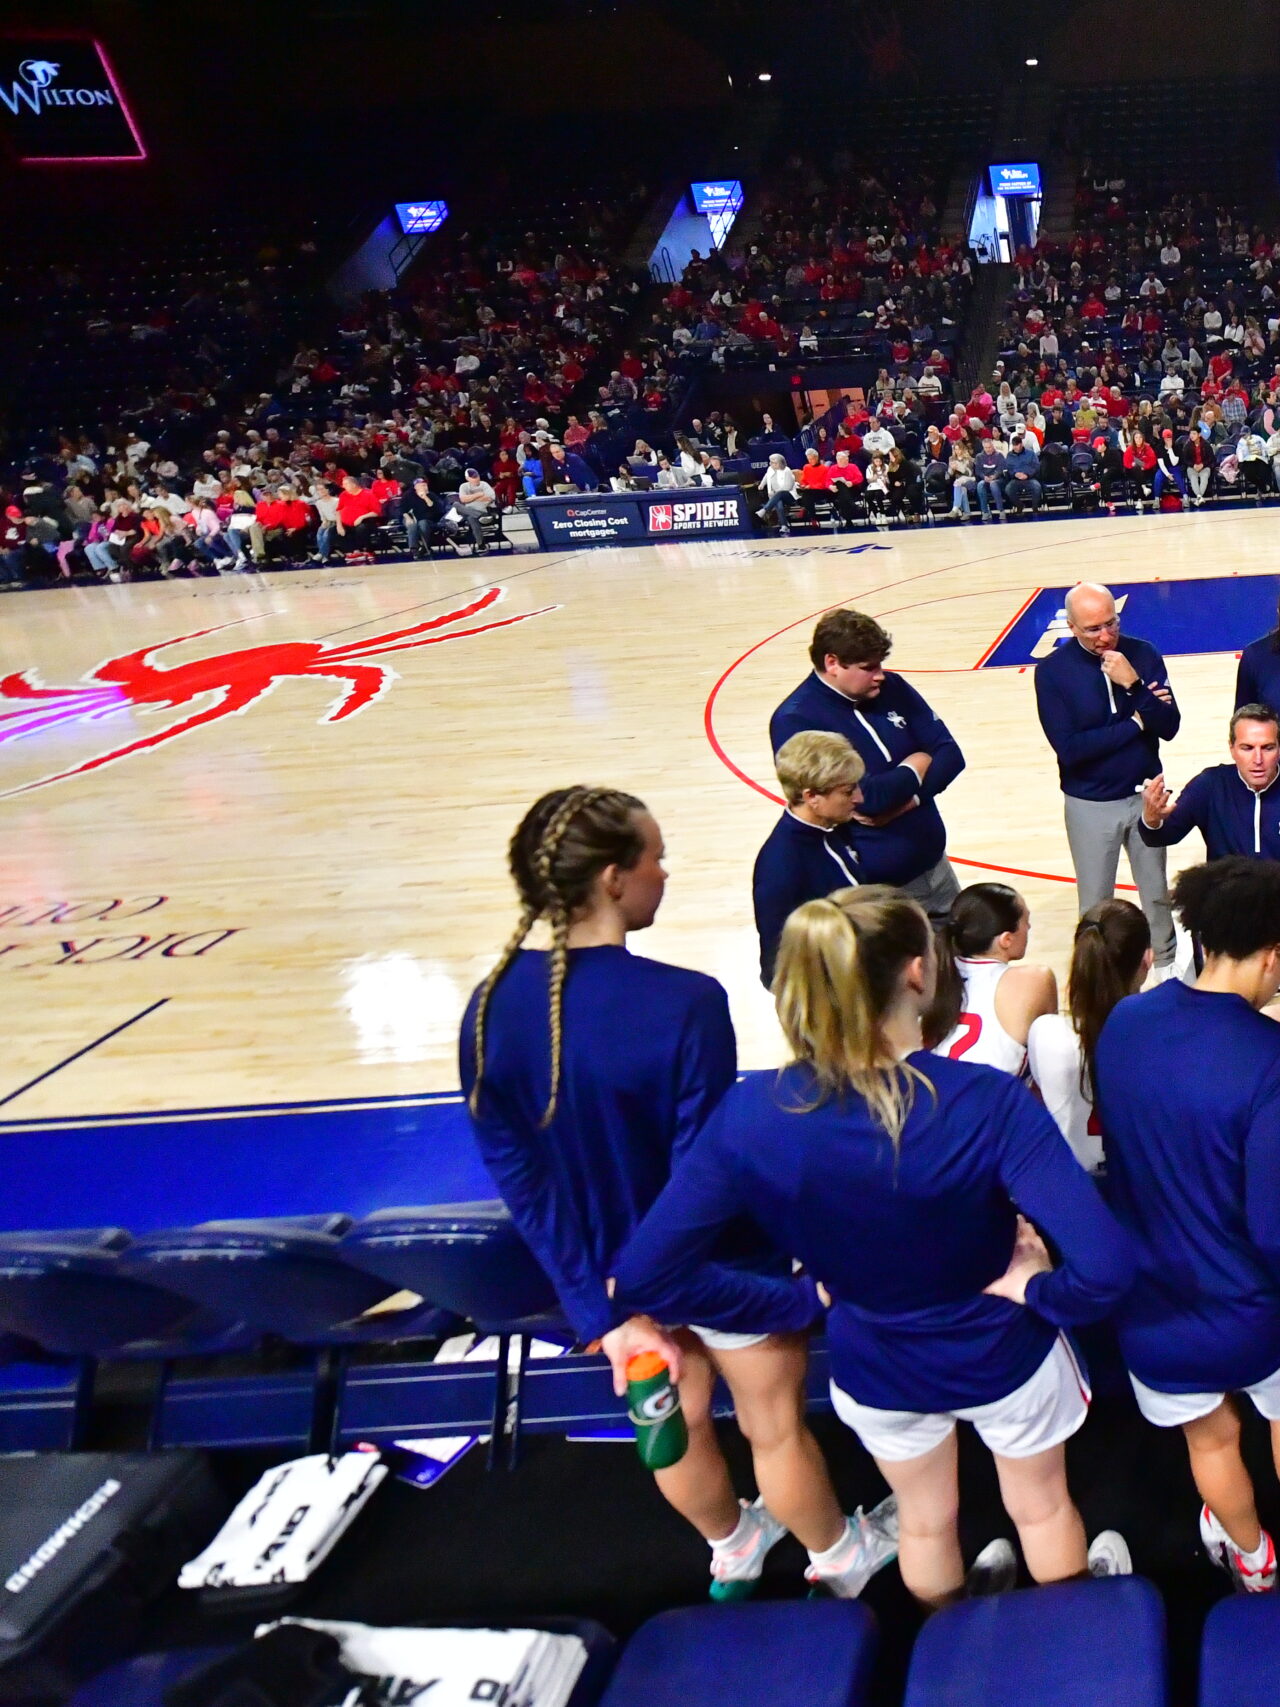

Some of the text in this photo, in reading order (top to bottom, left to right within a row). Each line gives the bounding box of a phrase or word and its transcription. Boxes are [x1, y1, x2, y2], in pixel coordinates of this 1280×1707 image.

[574, 509, 607, 517] CapCenter
[673, 500, 739, 521] SPIDER
[552, 517, 629, 529] Zero Closing Cost
[673, 518, 740, 530] SPORTS NETWORK
[569, 528, 618, 537] mortgages.
[5, 1479, 121, 1594] RICHMOND
